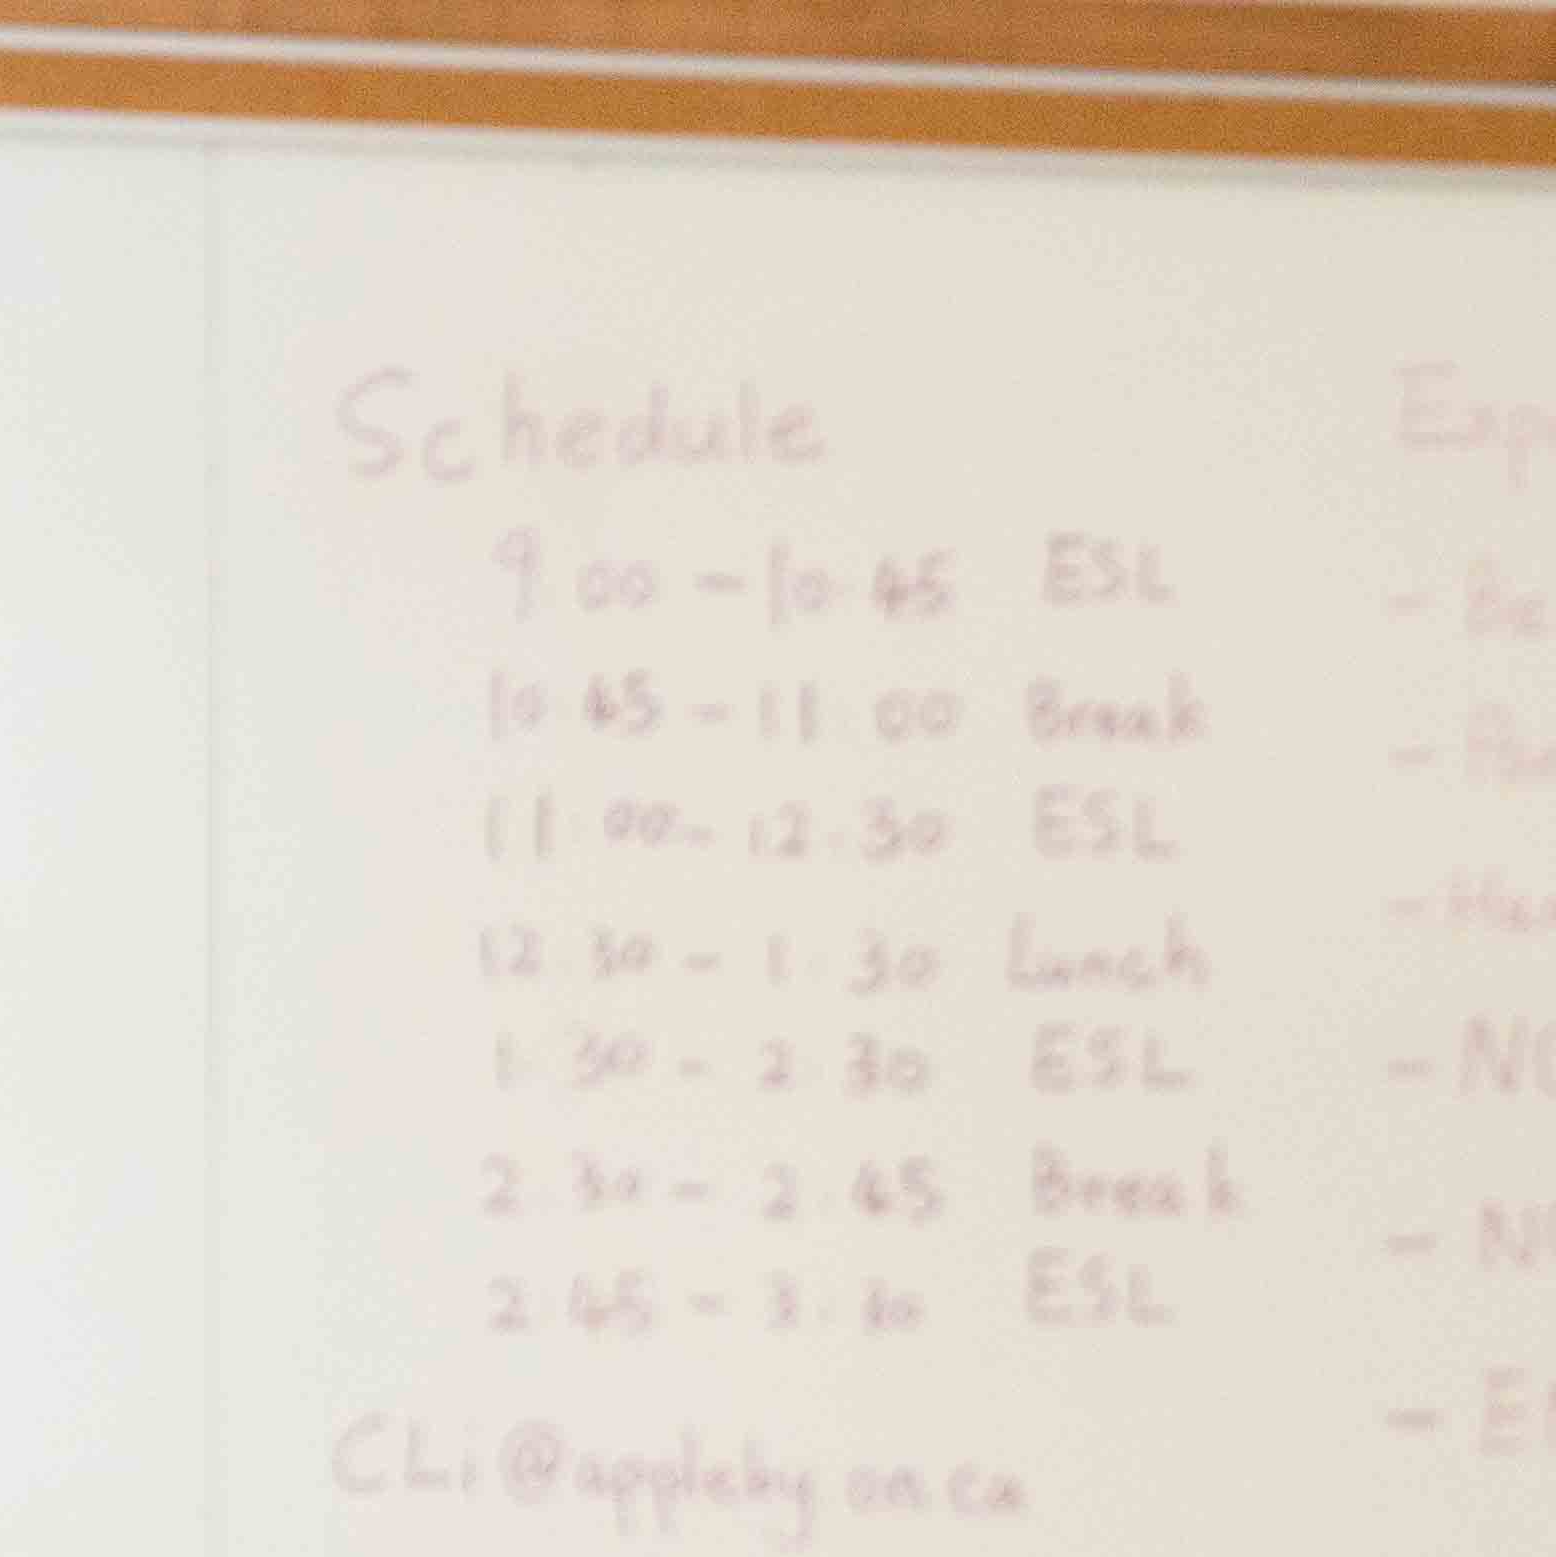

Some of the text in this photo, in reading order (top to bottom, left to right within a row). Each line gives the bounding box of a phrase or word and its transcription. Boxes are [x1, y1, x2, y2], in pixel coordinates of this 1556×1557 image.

[337, 365, 828, 483] Schedule
[1043, 530, 1176, 606] ESL
[1024, 671, 1210, 747] Break
[1033, 785, 1179, 863] ESL
[1007, 912, 1211, 994] Lunch
[1028, 1021, 1194, 1093] ESL
[1024, 1248, 1174, 1328] ESL
